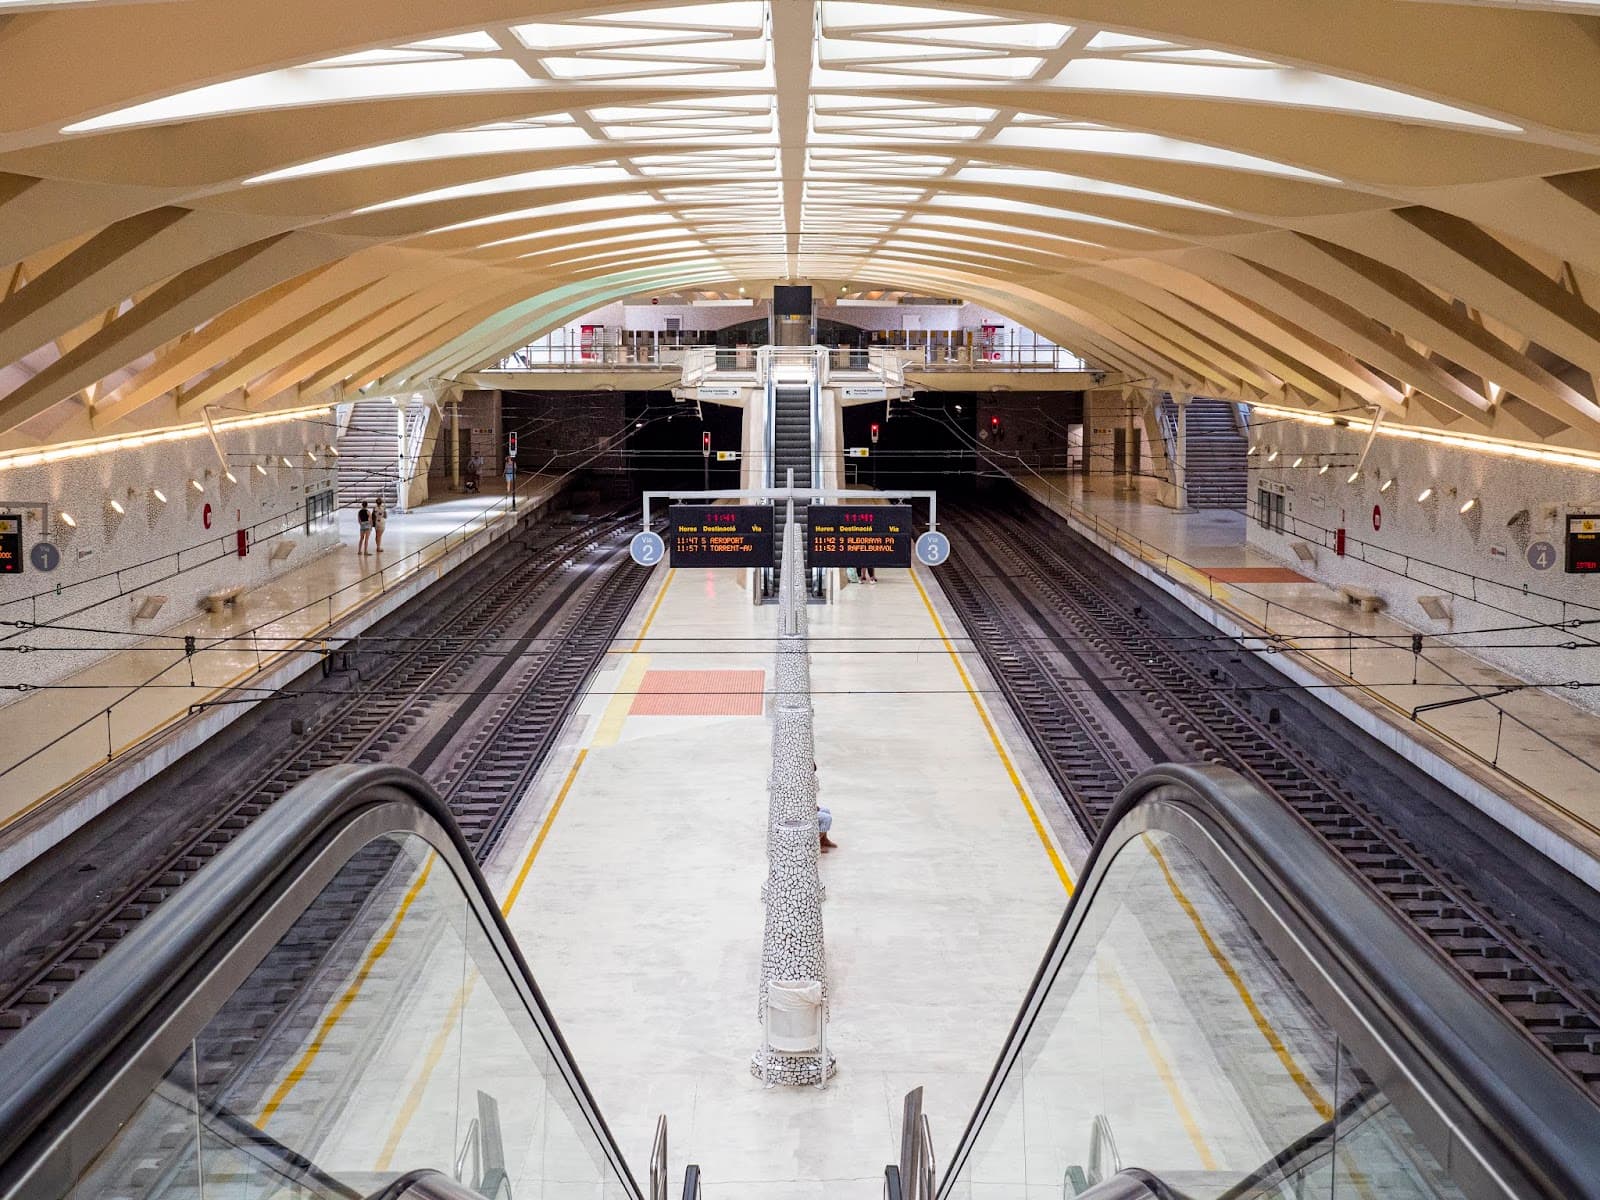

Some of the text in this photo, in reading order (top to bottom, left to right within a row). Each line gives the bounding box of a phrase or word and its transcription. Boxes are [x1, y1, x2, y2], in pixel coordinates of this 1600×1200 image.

[677, 536, 744, 544] 11:47 5 AEROPORT
[814, 536, 836, 544] 11:42
[839, 536, 845, 544] 9
[643, 545, 654, 561] 2
[927, 544, 938, 561] 3
[1536, 551, 1548, 568] 4
[40, 553, 48, 569] 1
